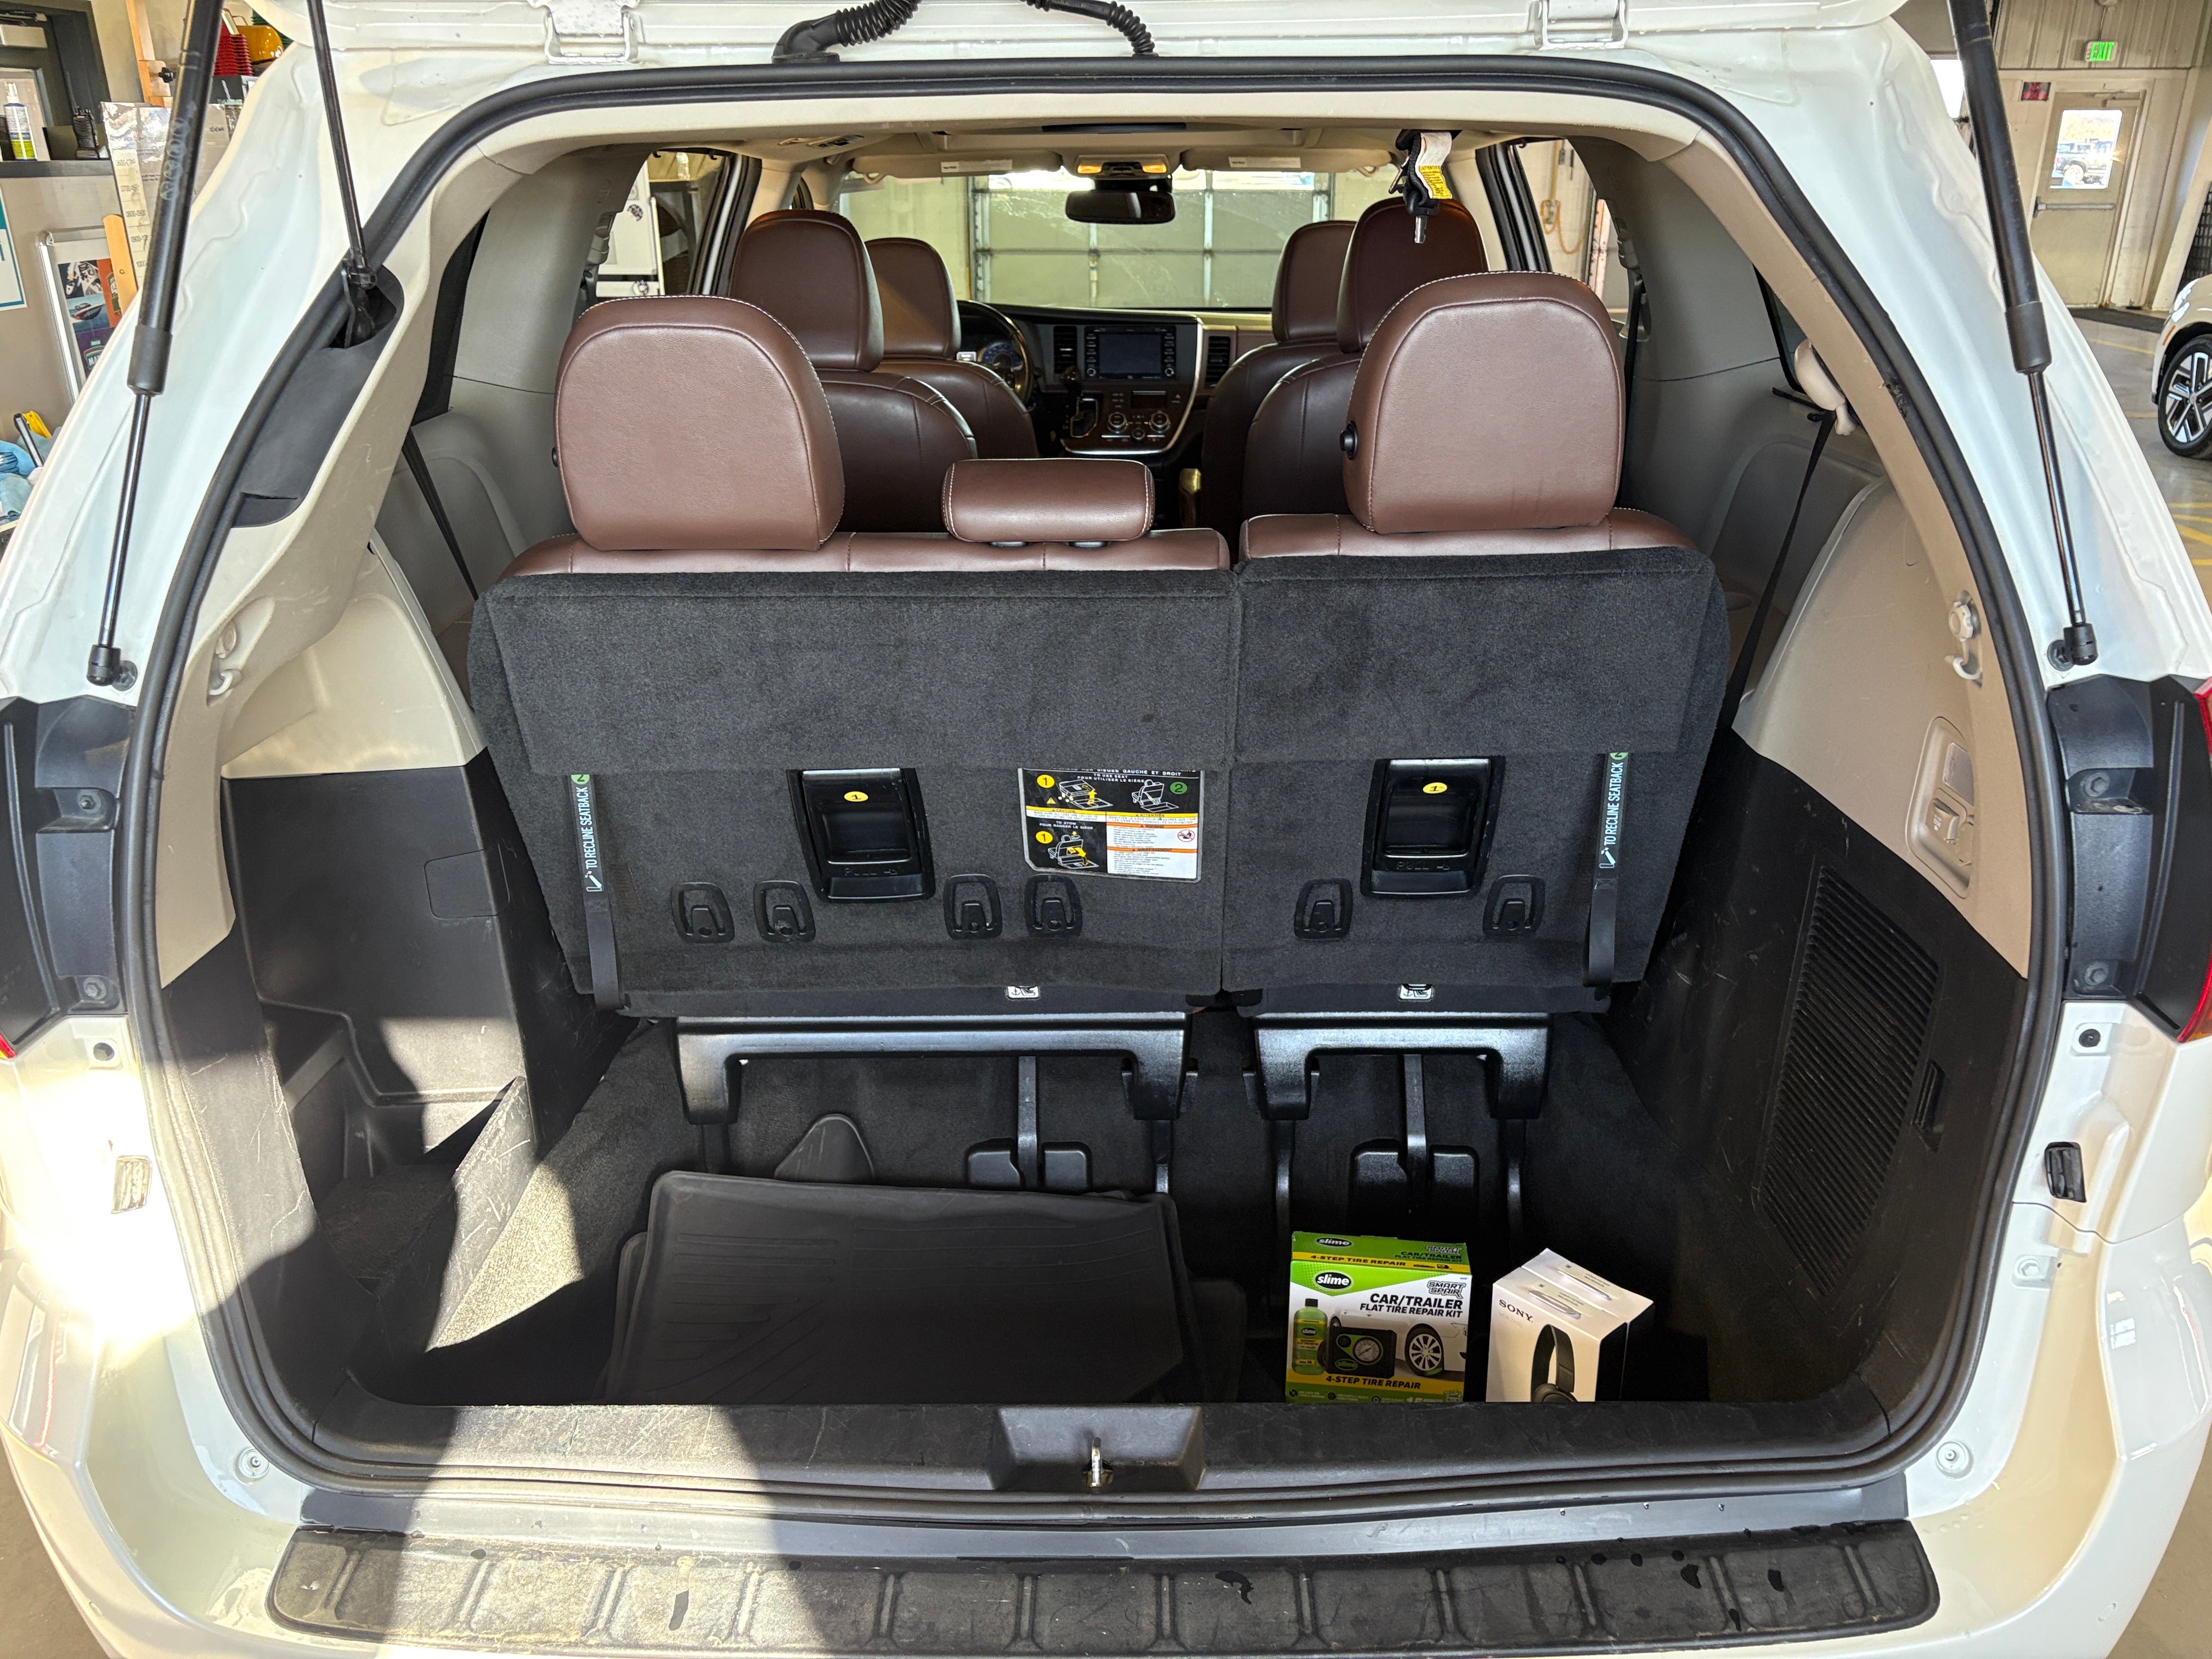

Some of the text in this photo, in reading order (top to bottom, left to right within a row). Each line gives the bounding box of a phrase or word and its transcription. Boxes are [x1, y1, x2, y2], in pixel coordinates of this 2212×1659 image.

[2089, 42, 2115, 61] EXIT
[577, 774, 585, 782] 2
[1043, 777, 1048, 786] 1
[1175, 783, 1183, 793] 2
[1604, 762, 1624, 846] TO RECLINE SEATBACK
[576, 787, 598, 870] TO RECLINE SEATBACK
[1042, 833, 1047, 842] 1
[1318, 1238, 1350, 1246] slime
[1401, 1251, 1462, 1260] CAR/TRAILER
[1317, 1273, 1350, 1286] slime
[1427, 1280, 1467, 1290] SMART
[1429, 1288, 1464, 1299] SPAIR
[1370, 1293, 1463, 1310] CAR/TRAILER
[1359, 1303, 1463, 1318] FLAT TIRE REPAIR KIT
[1499, 1299, 1533, 1322] SONY
[1326, 1376, 1421, 1390] 4-STEP TIRE REPAIR
